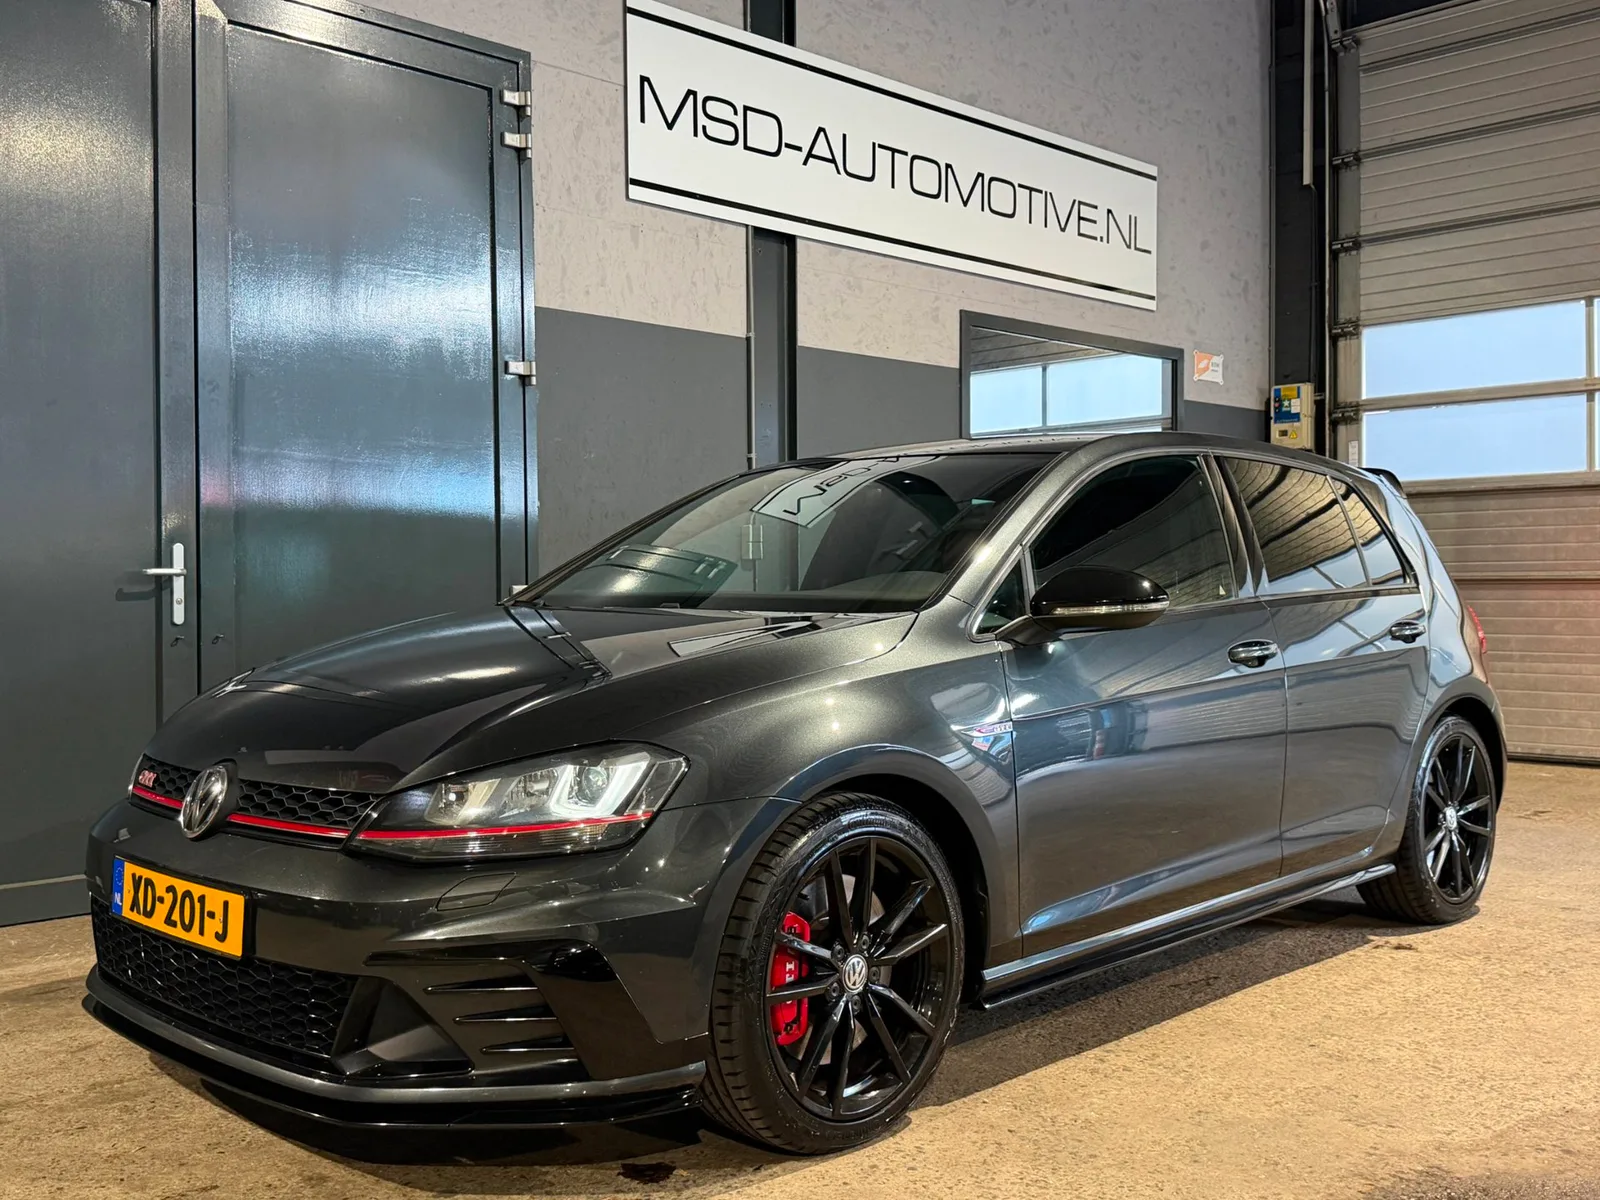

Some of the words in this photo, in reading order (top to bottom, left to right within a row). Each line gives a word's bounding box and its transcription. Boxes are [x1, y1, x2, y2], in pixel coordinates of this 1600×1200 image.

[639, 74, 1152, 255] MSD-AUTOMOTIVE.NL
[113, 892, 123, 906] NL
[129, 872, 229, 943] XD-201-J
